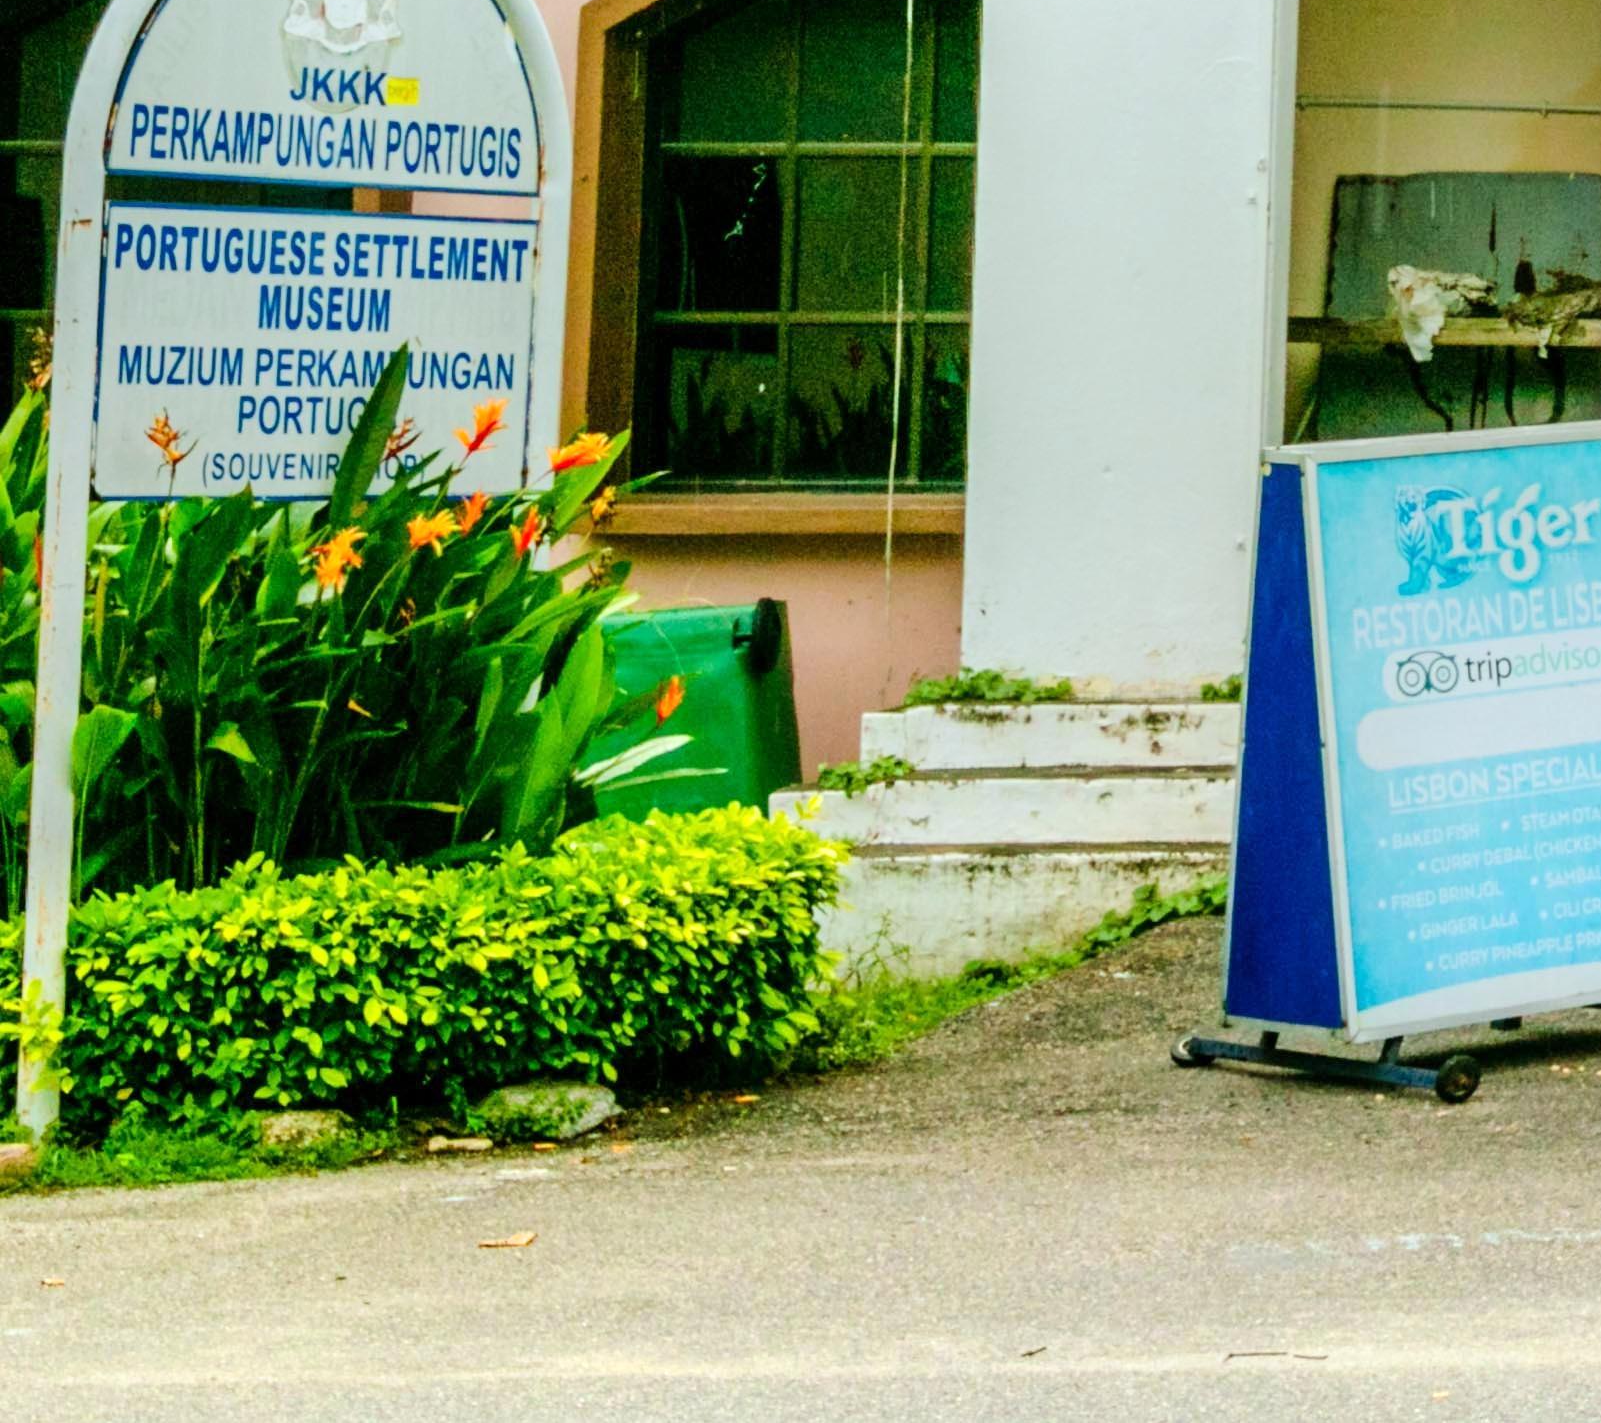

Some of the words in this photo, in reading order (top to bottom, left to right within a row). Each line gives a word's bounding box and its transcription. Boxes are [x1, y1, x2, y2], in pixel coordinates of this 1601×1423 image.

[290, 67, 387, 106] JKKK
[130, 103, 376, 171] PERKAMPUNGAN
[384, 120, 522, 179] PORTUGIS
[114, 223, 326, 276] PORTUGUESE
[333, 231, 529, 283] SETTLEMENT
[258, 284, 392, 333] MUSEUM
[118, 345, 244, 387] MUZIUM
[255, 348, 515, 391] PERKAMUNGAN
[1434, 482, 1601, 582] Tiger
[1353, 593, 1502, 650] RESTORAN
[1509, 587, 1547, 633] DE
[1389, 767, 1490, 809] LISBON
[1392, 826, 1444, 850] BAKED
[1446, 823, 1480, 842] FISH
[1521, 810, 1568, 832] STEAM
[1430, 851, 1480, 874] CURRY
[1392, 889, 1436, 911] FRIED
[1420, 916, 1477, 941] GINGER
[1481, 911, 1520, 932] LALA
[1438, 947, 1490, 971] CURRY
[1492, 936, 1573, 962] PINEAPPLE
